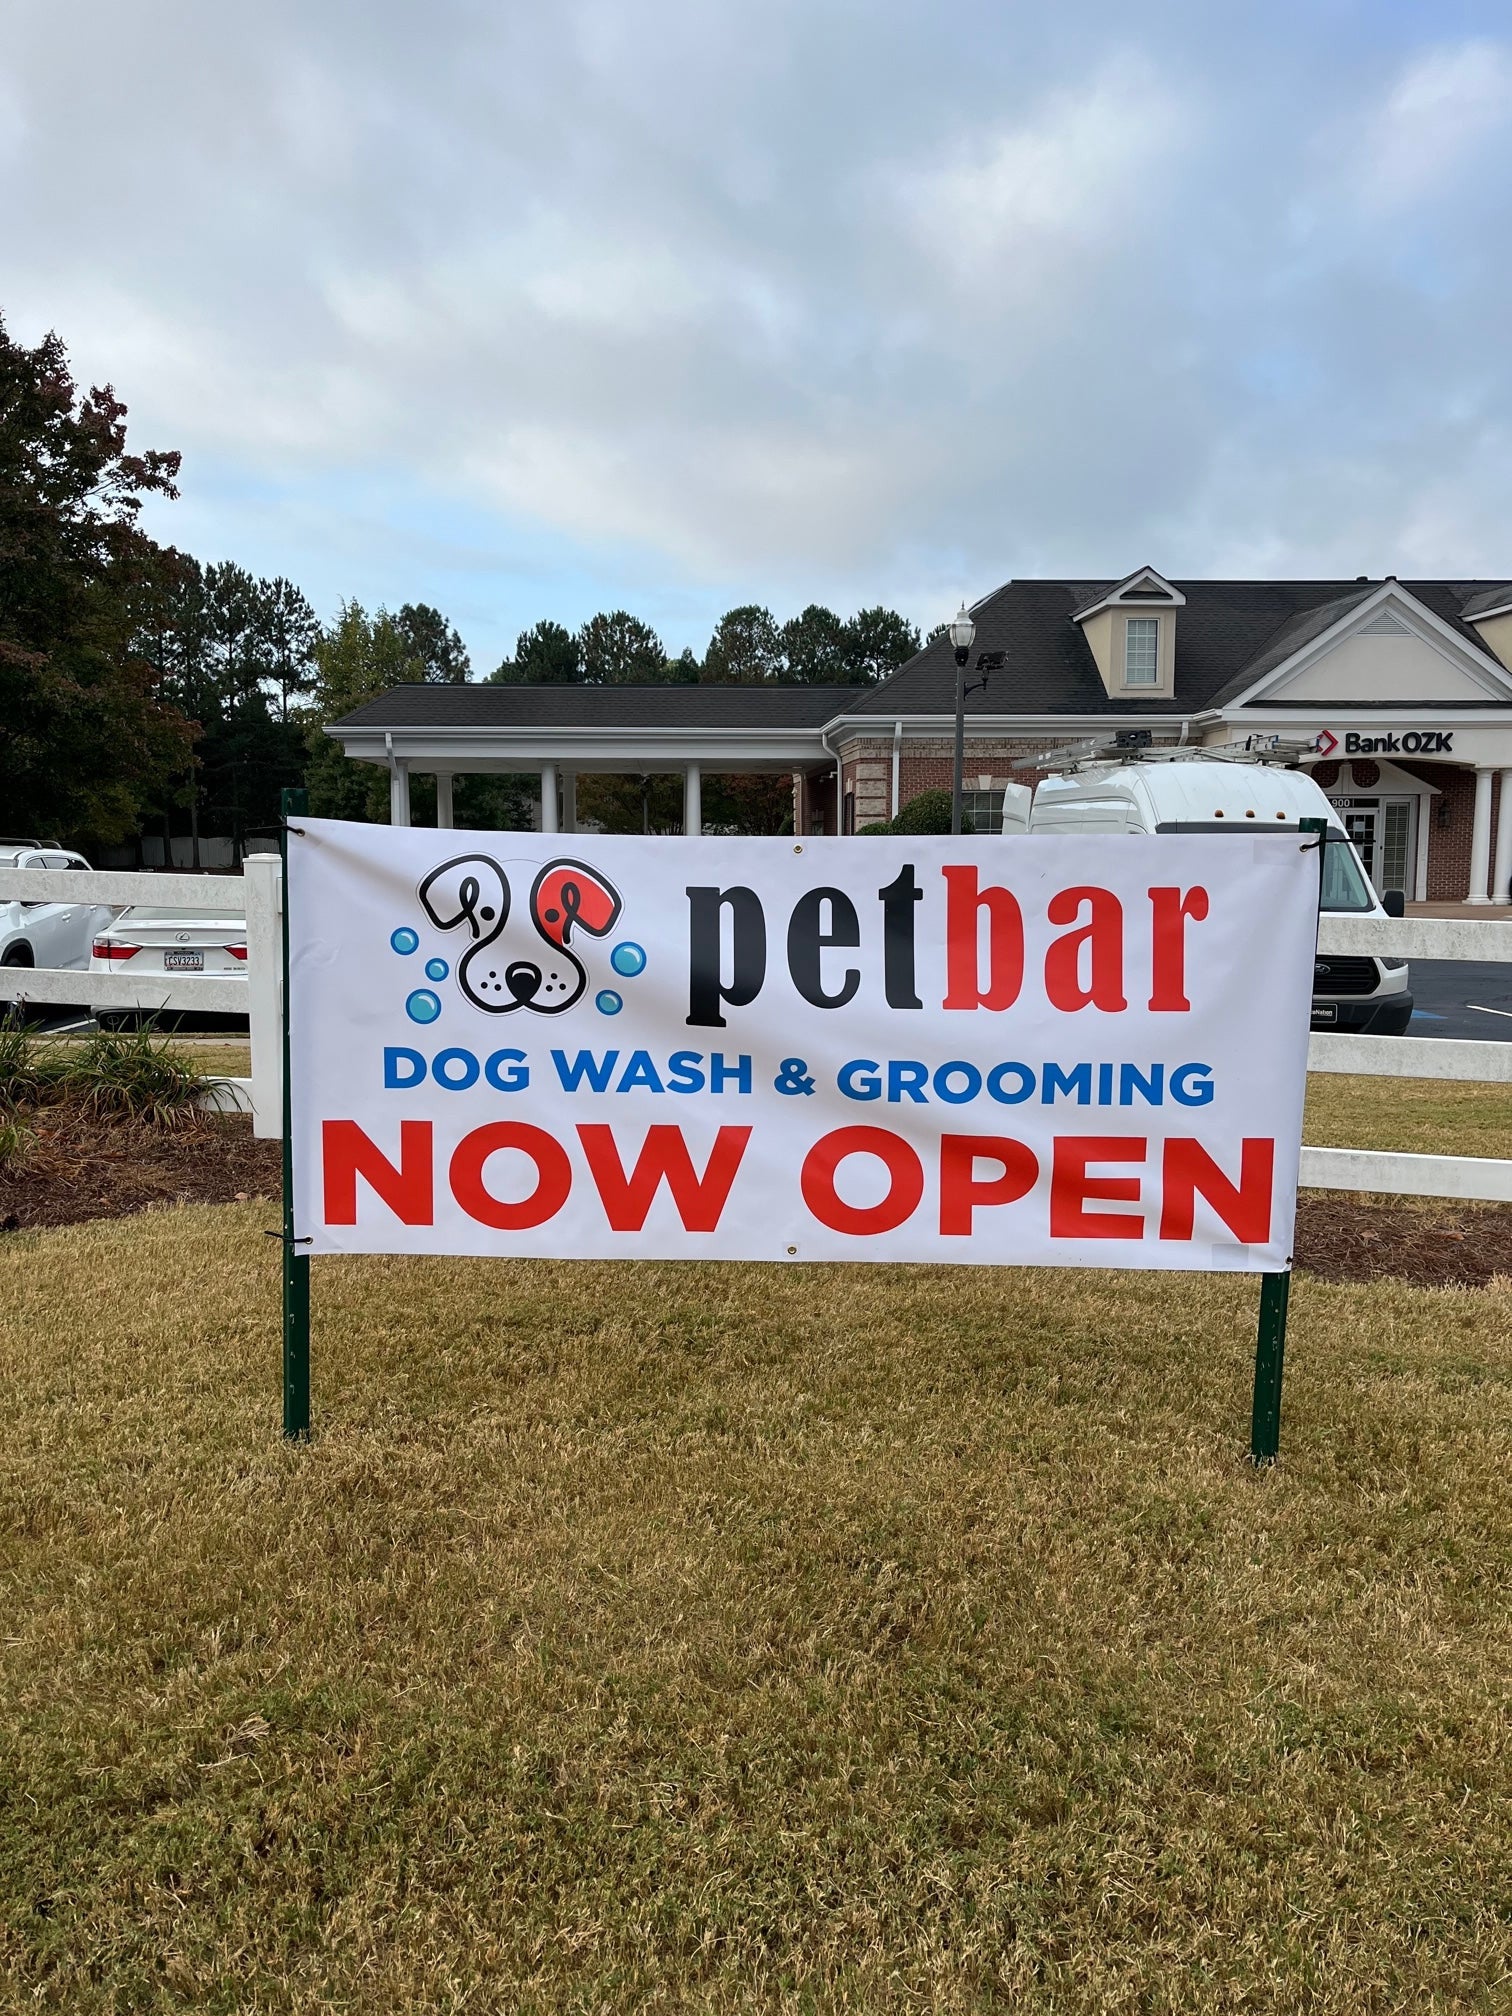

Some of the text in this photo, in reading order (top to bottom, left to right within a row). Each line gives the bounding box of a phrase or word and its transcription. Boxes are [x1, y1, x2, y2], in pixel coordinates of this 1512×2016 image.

[167, 955, 200, 967] CSV3233
[686, 864, 1209, 1028] petbar
[384, 1046, 1215, 1107] DOG WASH & GROOMING
[322, 1119, 1275, 1243] NOW OPEN
